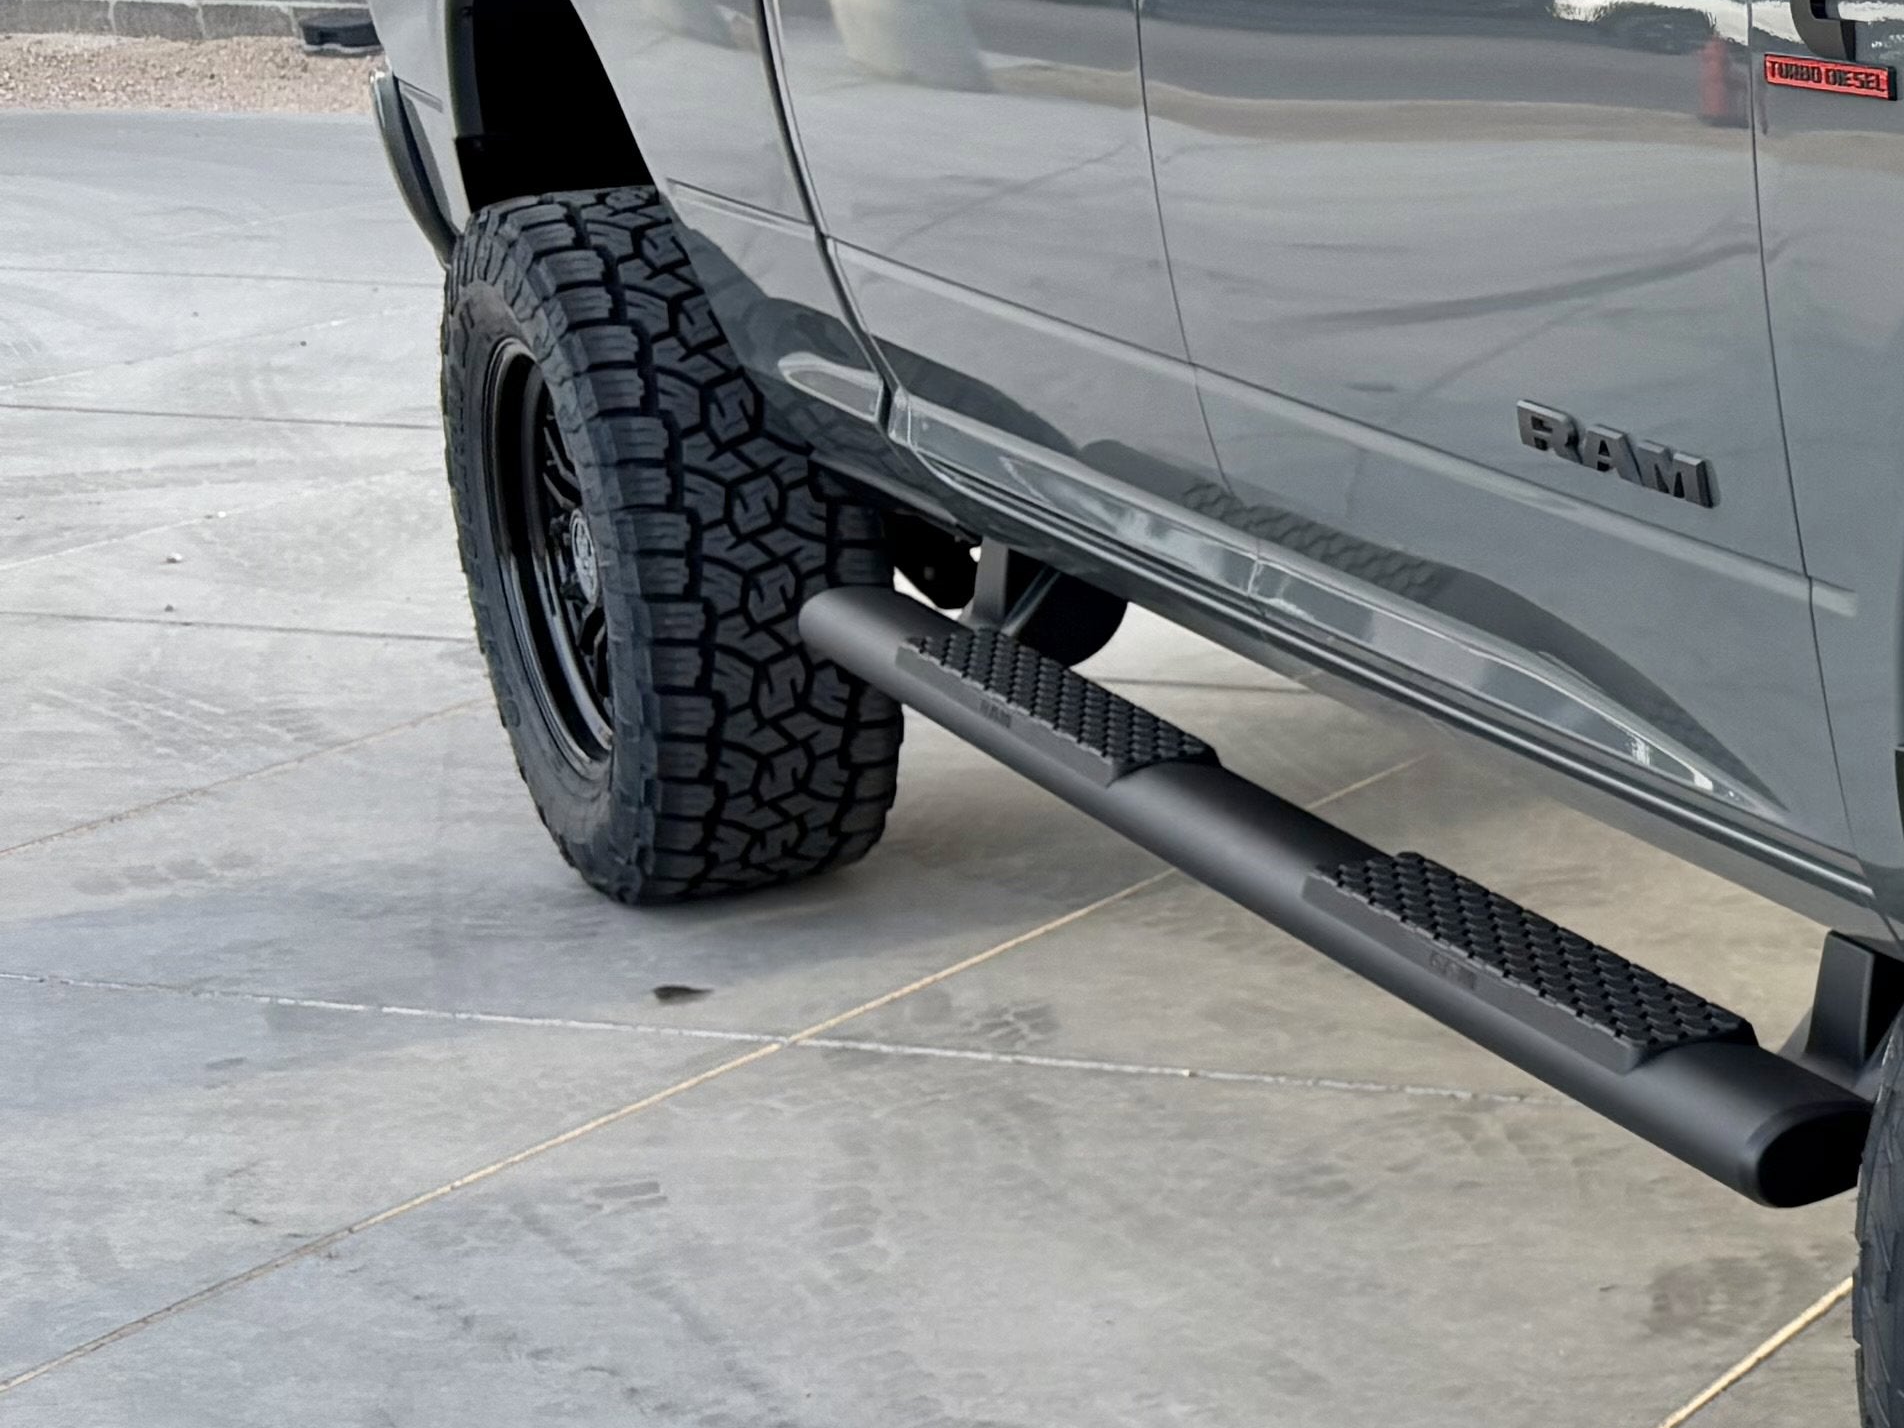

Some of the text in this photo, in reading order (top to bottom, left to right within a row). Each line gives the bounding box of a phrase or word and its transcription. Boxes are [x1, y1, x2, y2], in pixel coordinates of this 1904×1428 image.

[1769, 61, 1886, 92] TURBO DIESEL
[1517, 398, 1720, 508] RAM
